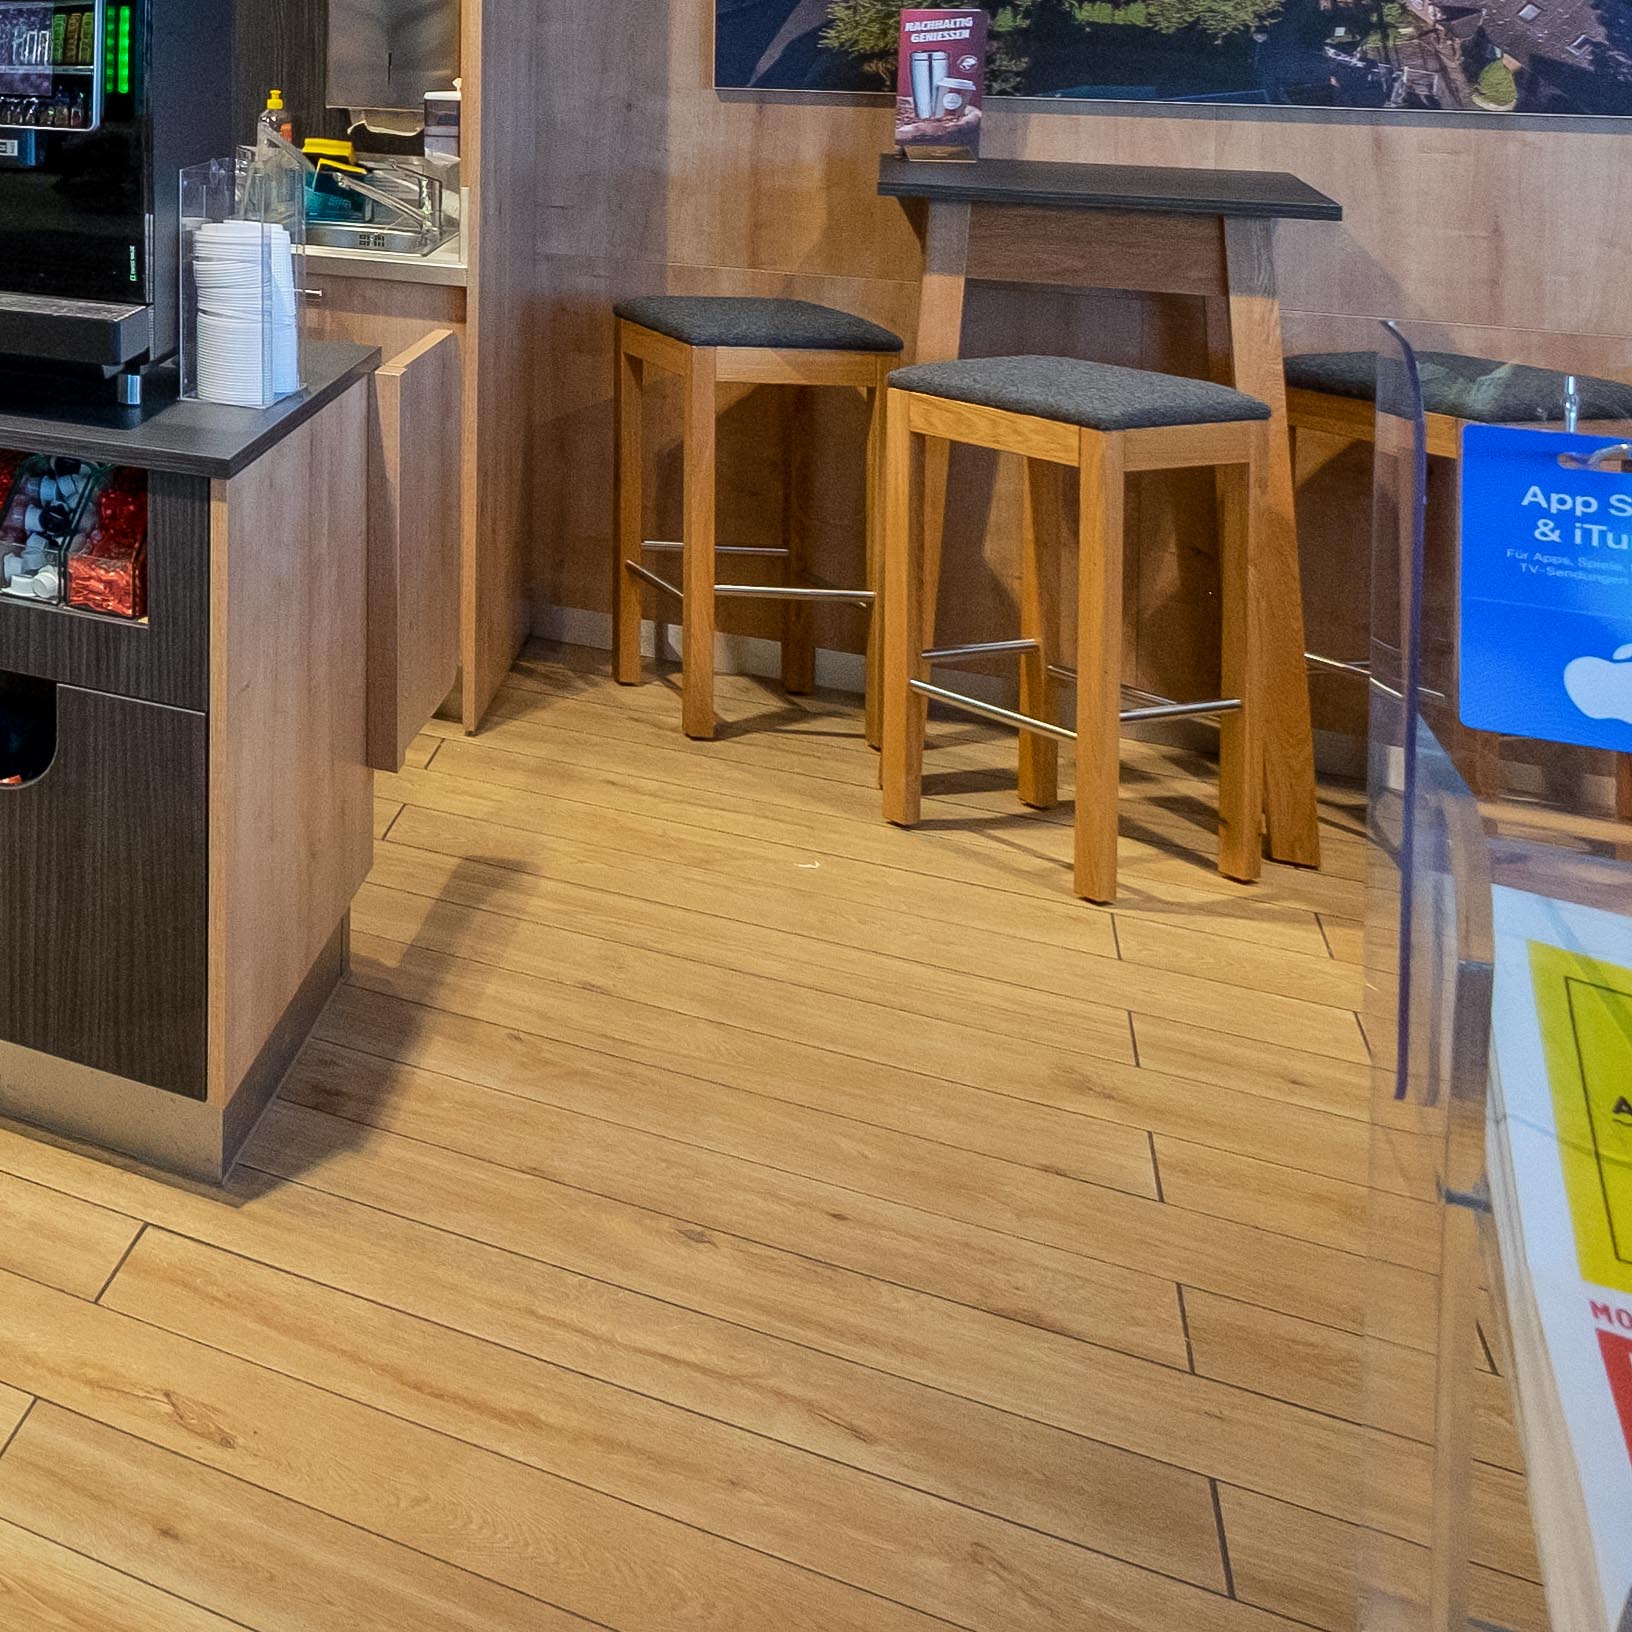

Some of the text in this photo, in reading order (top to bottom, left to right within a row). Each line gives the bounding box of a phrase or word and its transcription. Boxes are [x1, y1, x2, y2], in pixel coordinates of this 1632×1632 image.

[904, 17, 973, 33] NACHHALTIG
[910, 29, 971, 43] GENIESSEN
[1520, 485, 1598, 517] App
[1534, 518, 1632, 550] & iTu
[1506, 548, 1529, 559] Für
